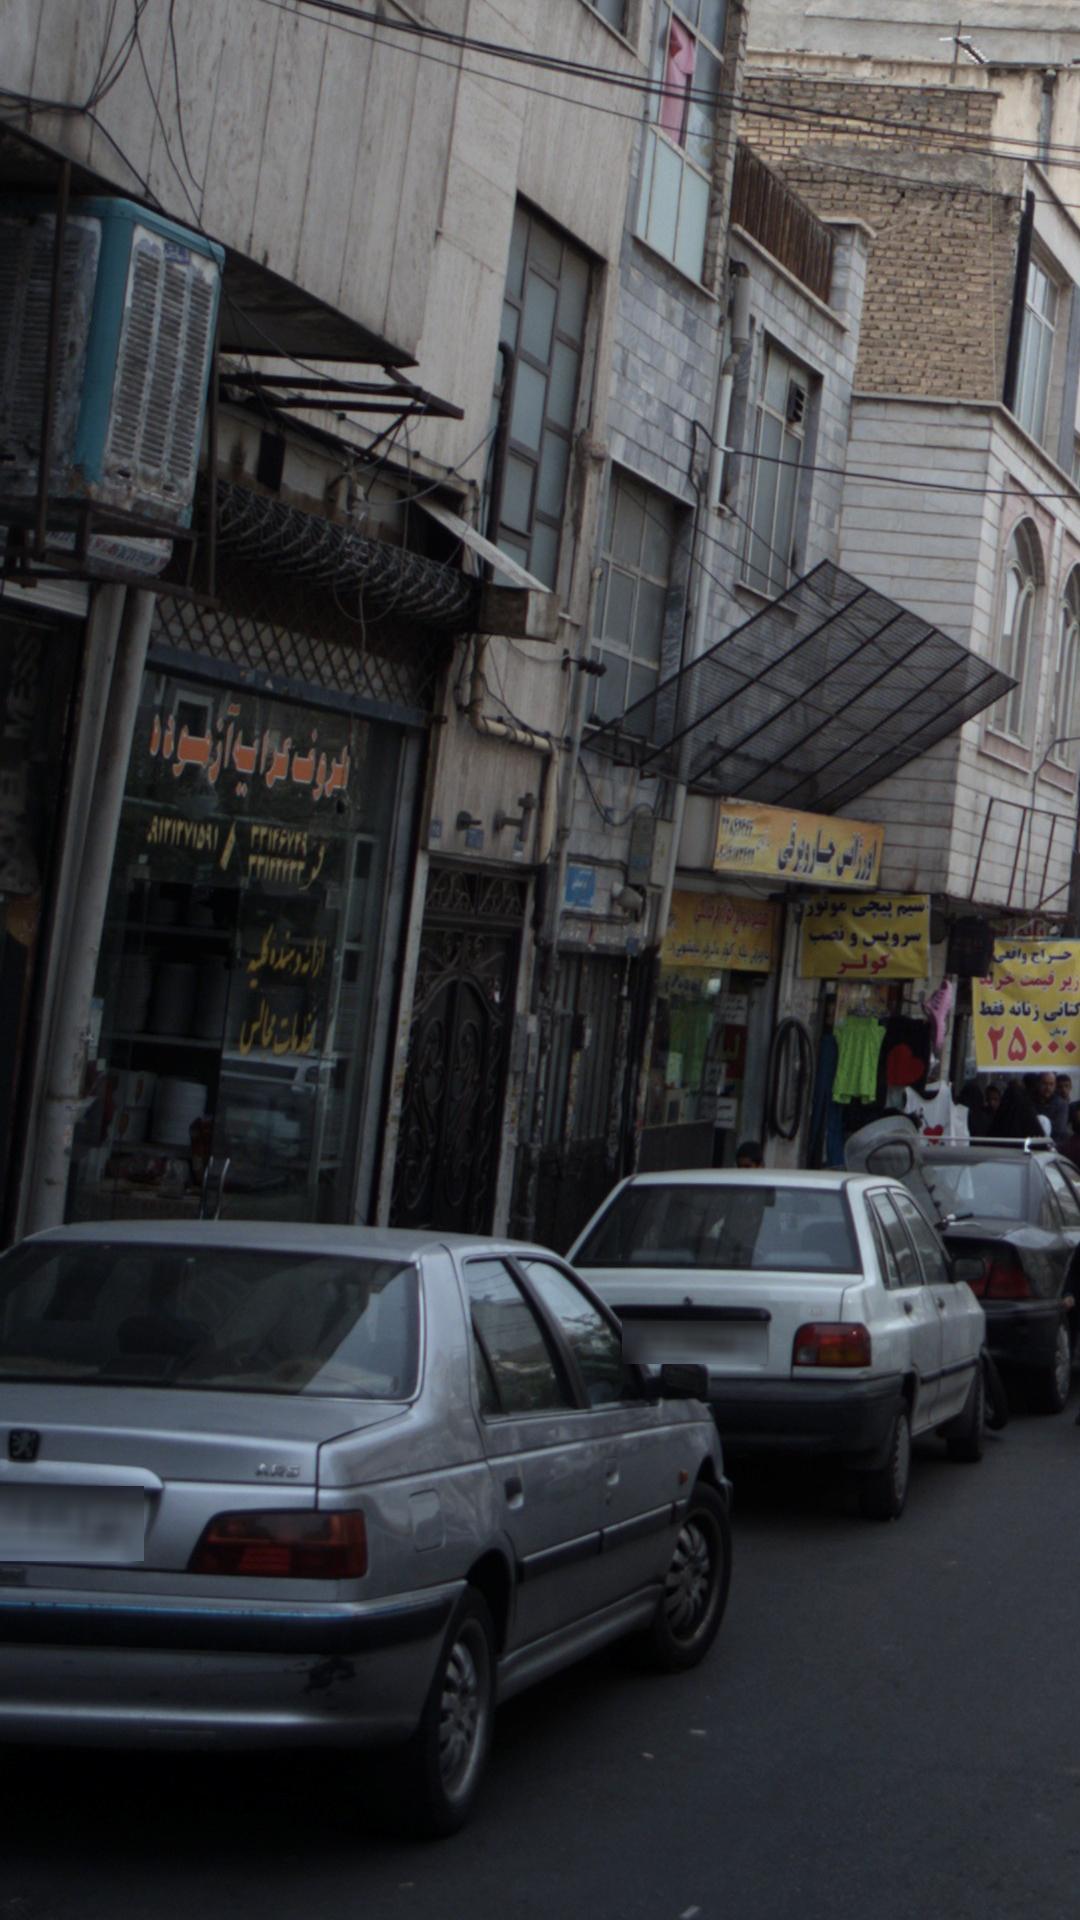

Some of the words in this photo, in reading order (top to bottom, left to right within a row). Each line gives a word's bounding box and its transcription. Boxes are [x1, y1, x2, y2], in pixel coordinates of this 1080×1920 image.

[149, 703, 240, 785] آزموده
[233, 729, 292, 798] کرایه
[807, 897, 847, 916] موتور
[852, 900, 892, 918] پیچی
[896, 902, 926, 917] سیم
[808, 924, 845, 945] نصب
[848, 932, 859, 947] و
[863, 930, 921, 947] سرویس
[836, 952, 891, 975] کولر
[993, 947, 1028, 964] واقعی
[1031, 948, 1073, 965] حراج
[1020, 970, 1055, 992] قیمت
[1059, 975, 1080, 992] زیر
[979, 999, 1006, 1017] فقط
[1008, 999, 1040, 1022] زنانه
[986, 1025, 1077, 1062] ۲۵۰۰۰
